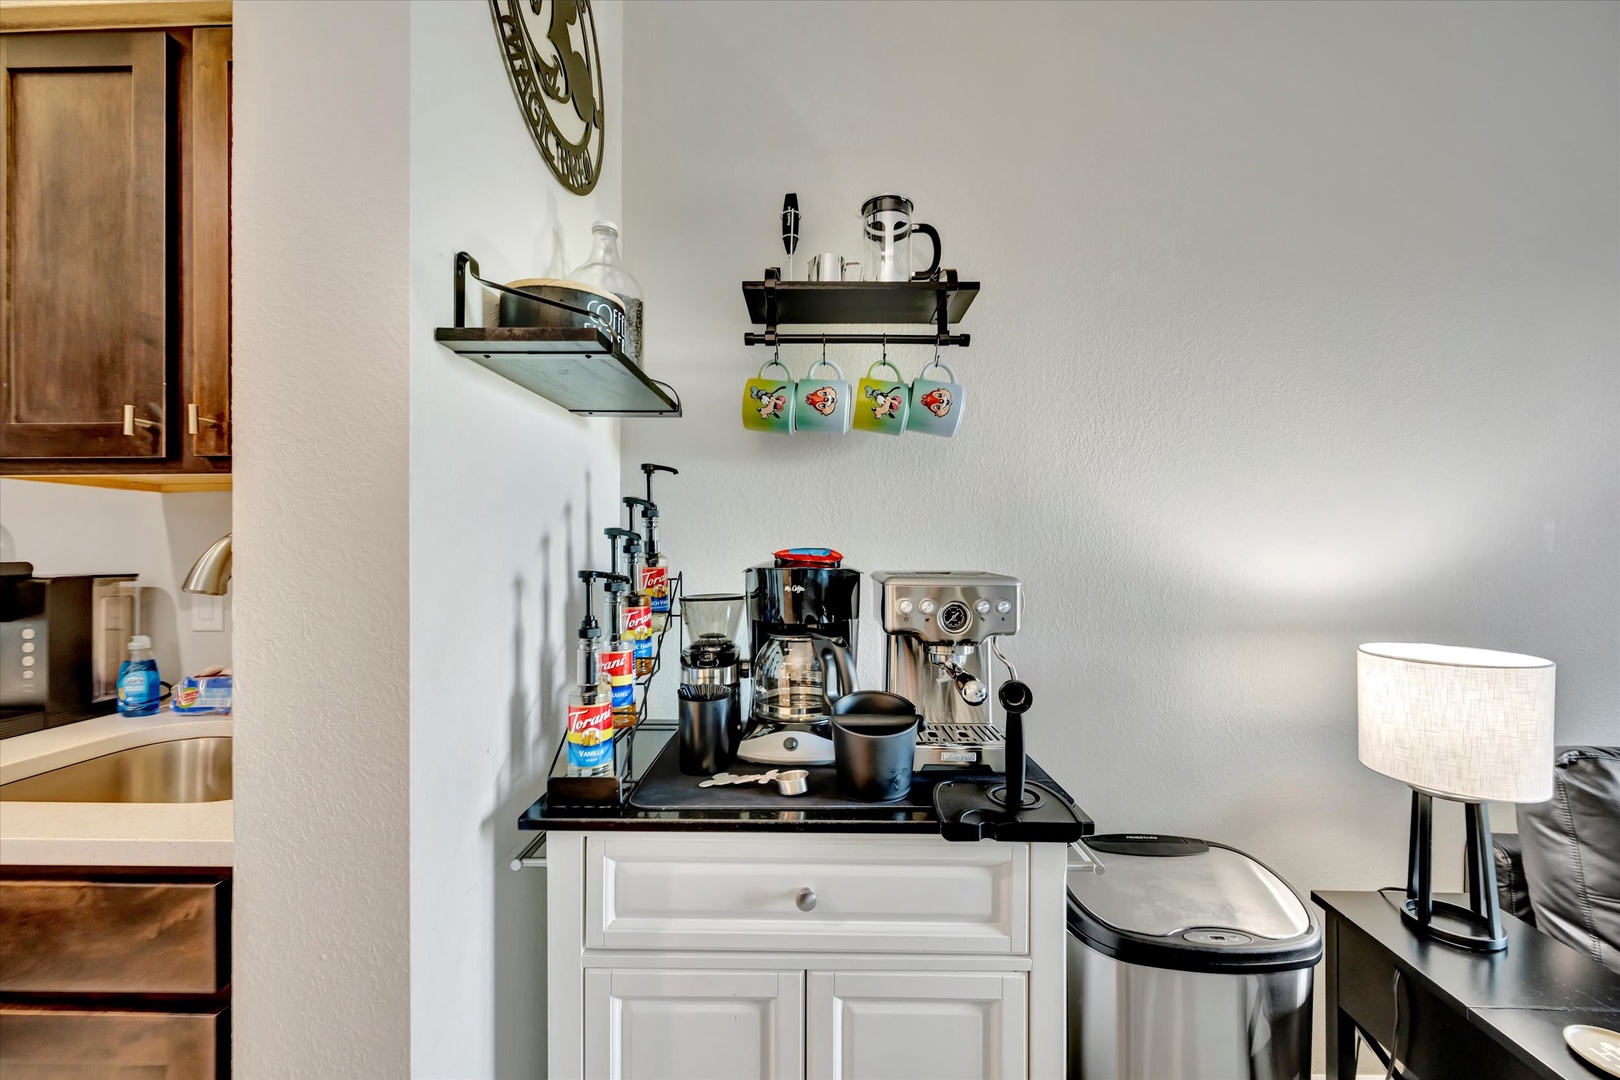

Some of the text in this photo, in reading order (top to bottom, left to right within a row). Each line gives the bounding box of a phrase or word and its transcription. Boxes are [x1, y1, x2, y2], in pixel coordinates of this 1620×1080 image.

[587, 300, 625, 337] COFFE
[642, 570, 668, 590] Tora
[622, 610, 652, 629] Toran
[569, 704, 612, 734] Torani
[579, 749, 604, 757] VANILLA
